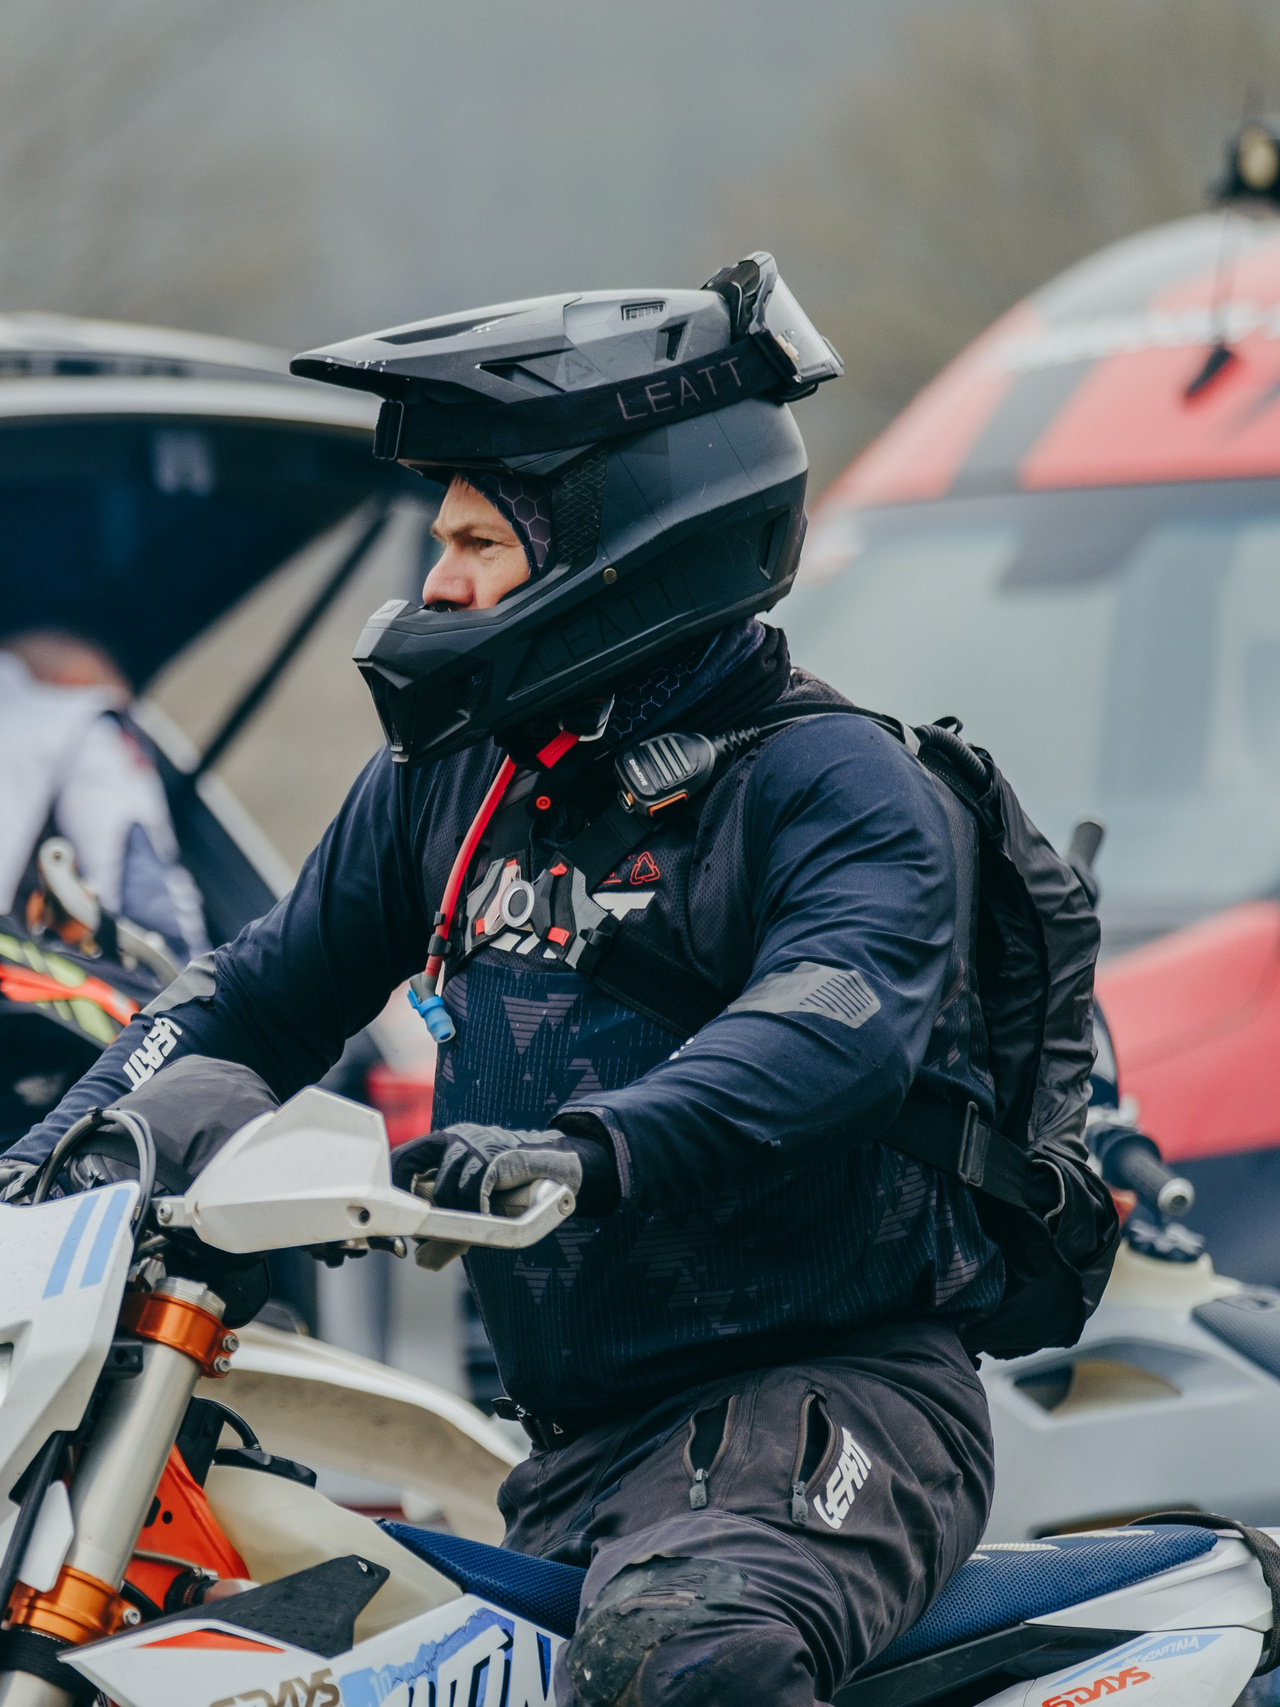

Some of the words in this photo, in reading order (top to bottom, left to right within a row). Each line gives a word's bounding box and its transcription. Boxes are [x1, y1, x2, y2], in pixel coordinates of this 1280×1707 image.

[616, 356, 742, 421] LEATT
[529, 571, 675, 677] LEATT
[122, 1017, 183, 1092] LEATT
[813, 1427, 873, 1530] LEATT
[209, 1668, 342, 1707] DAYS
